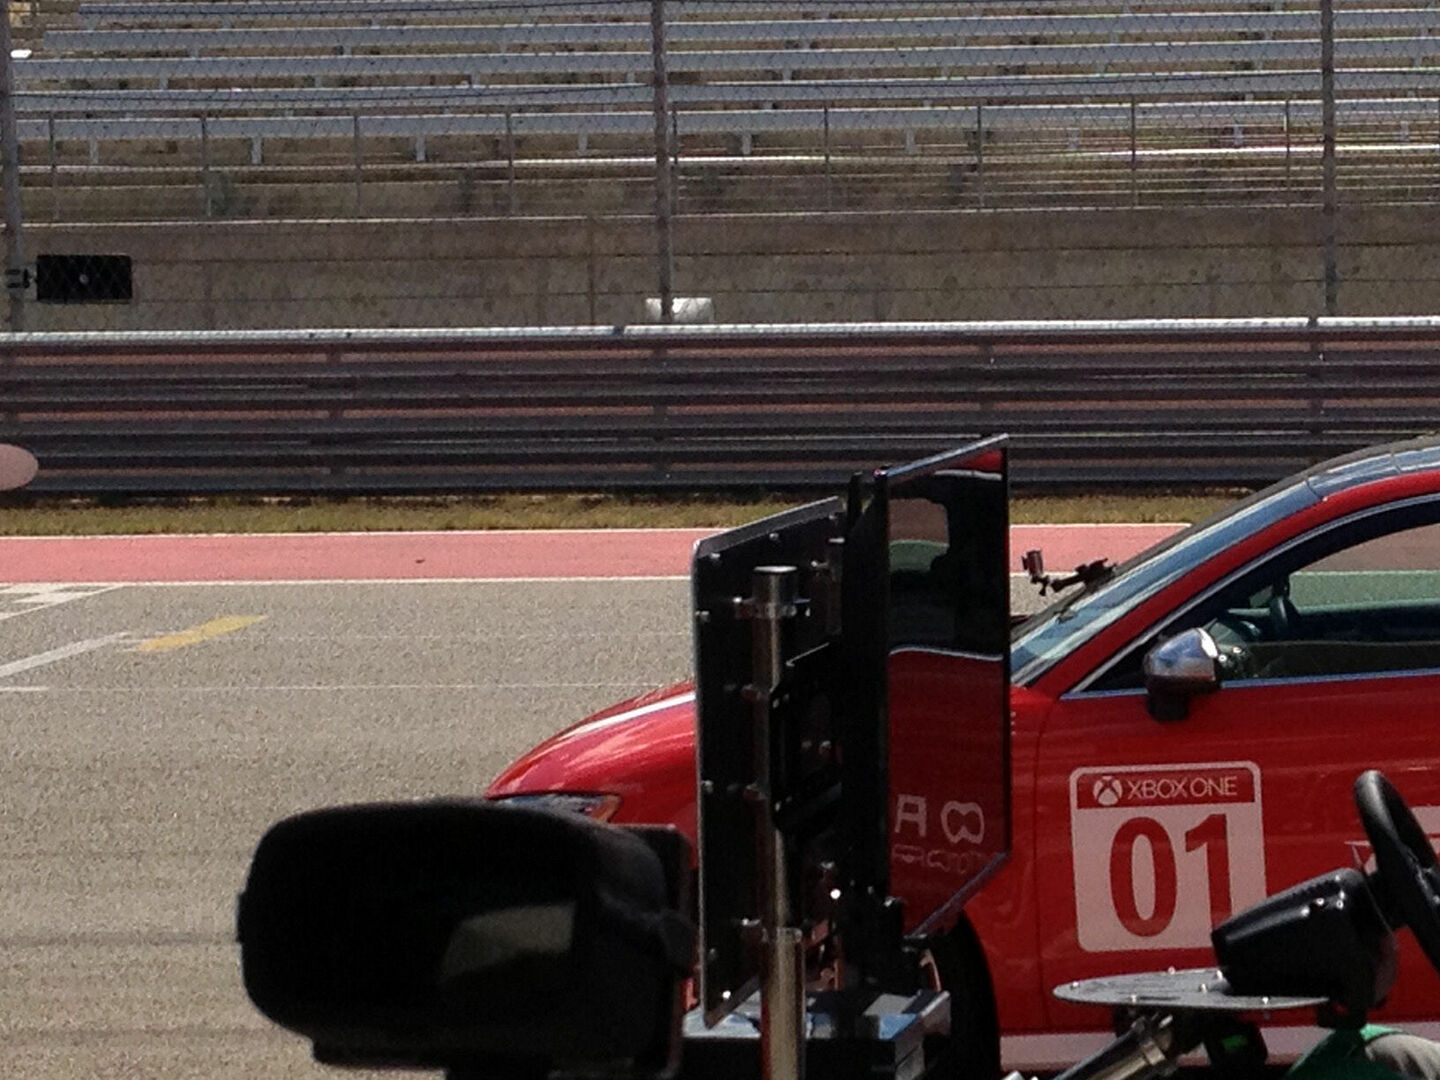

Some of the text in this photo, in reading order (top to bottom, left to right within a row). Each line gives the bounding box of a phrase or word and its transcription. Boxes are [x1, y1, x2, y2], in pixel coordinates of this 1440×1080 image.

[1127, 775, 1239, 800] XBOX ONE
[1109, 812, 1234, 938] 01
